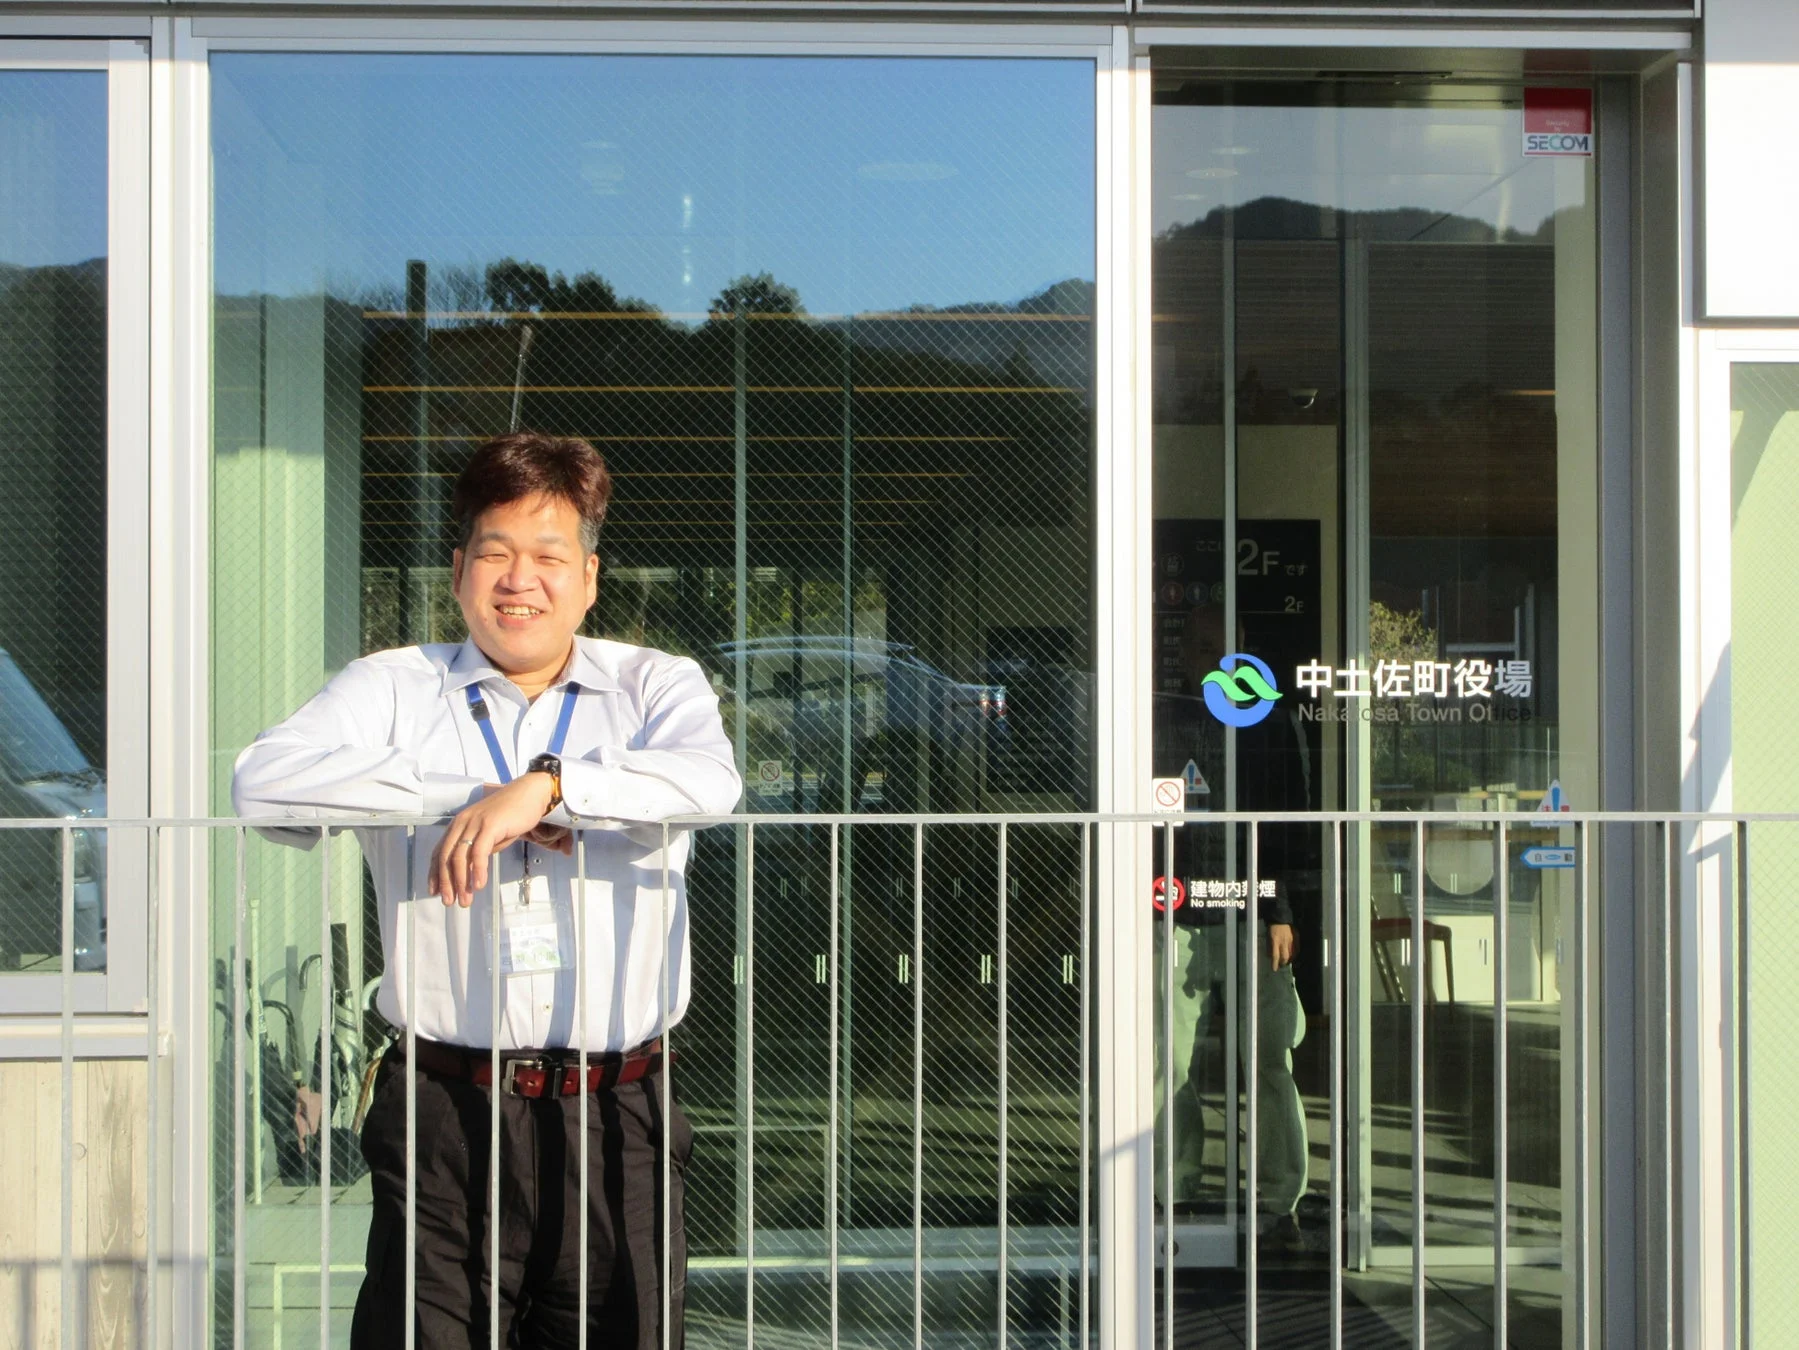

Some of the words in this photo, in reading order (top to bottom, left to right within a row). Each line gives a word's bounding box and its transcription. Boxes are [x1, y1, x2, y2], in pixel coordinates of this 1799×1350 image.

[1527, 134, 1589, 151] SECOM
[1236, 538, 1281, 576] 2F
[1284, 595, 1304, 613] 2F
[1296, 658, 1533, 698] 中土佐町役場
[1298, 703, 1399, 722] Nakaosa
[1405, 703, 1462, 722] Town
[1190, 899, 1204, 908] No
[1206, 899, 1246, 910] smoking
